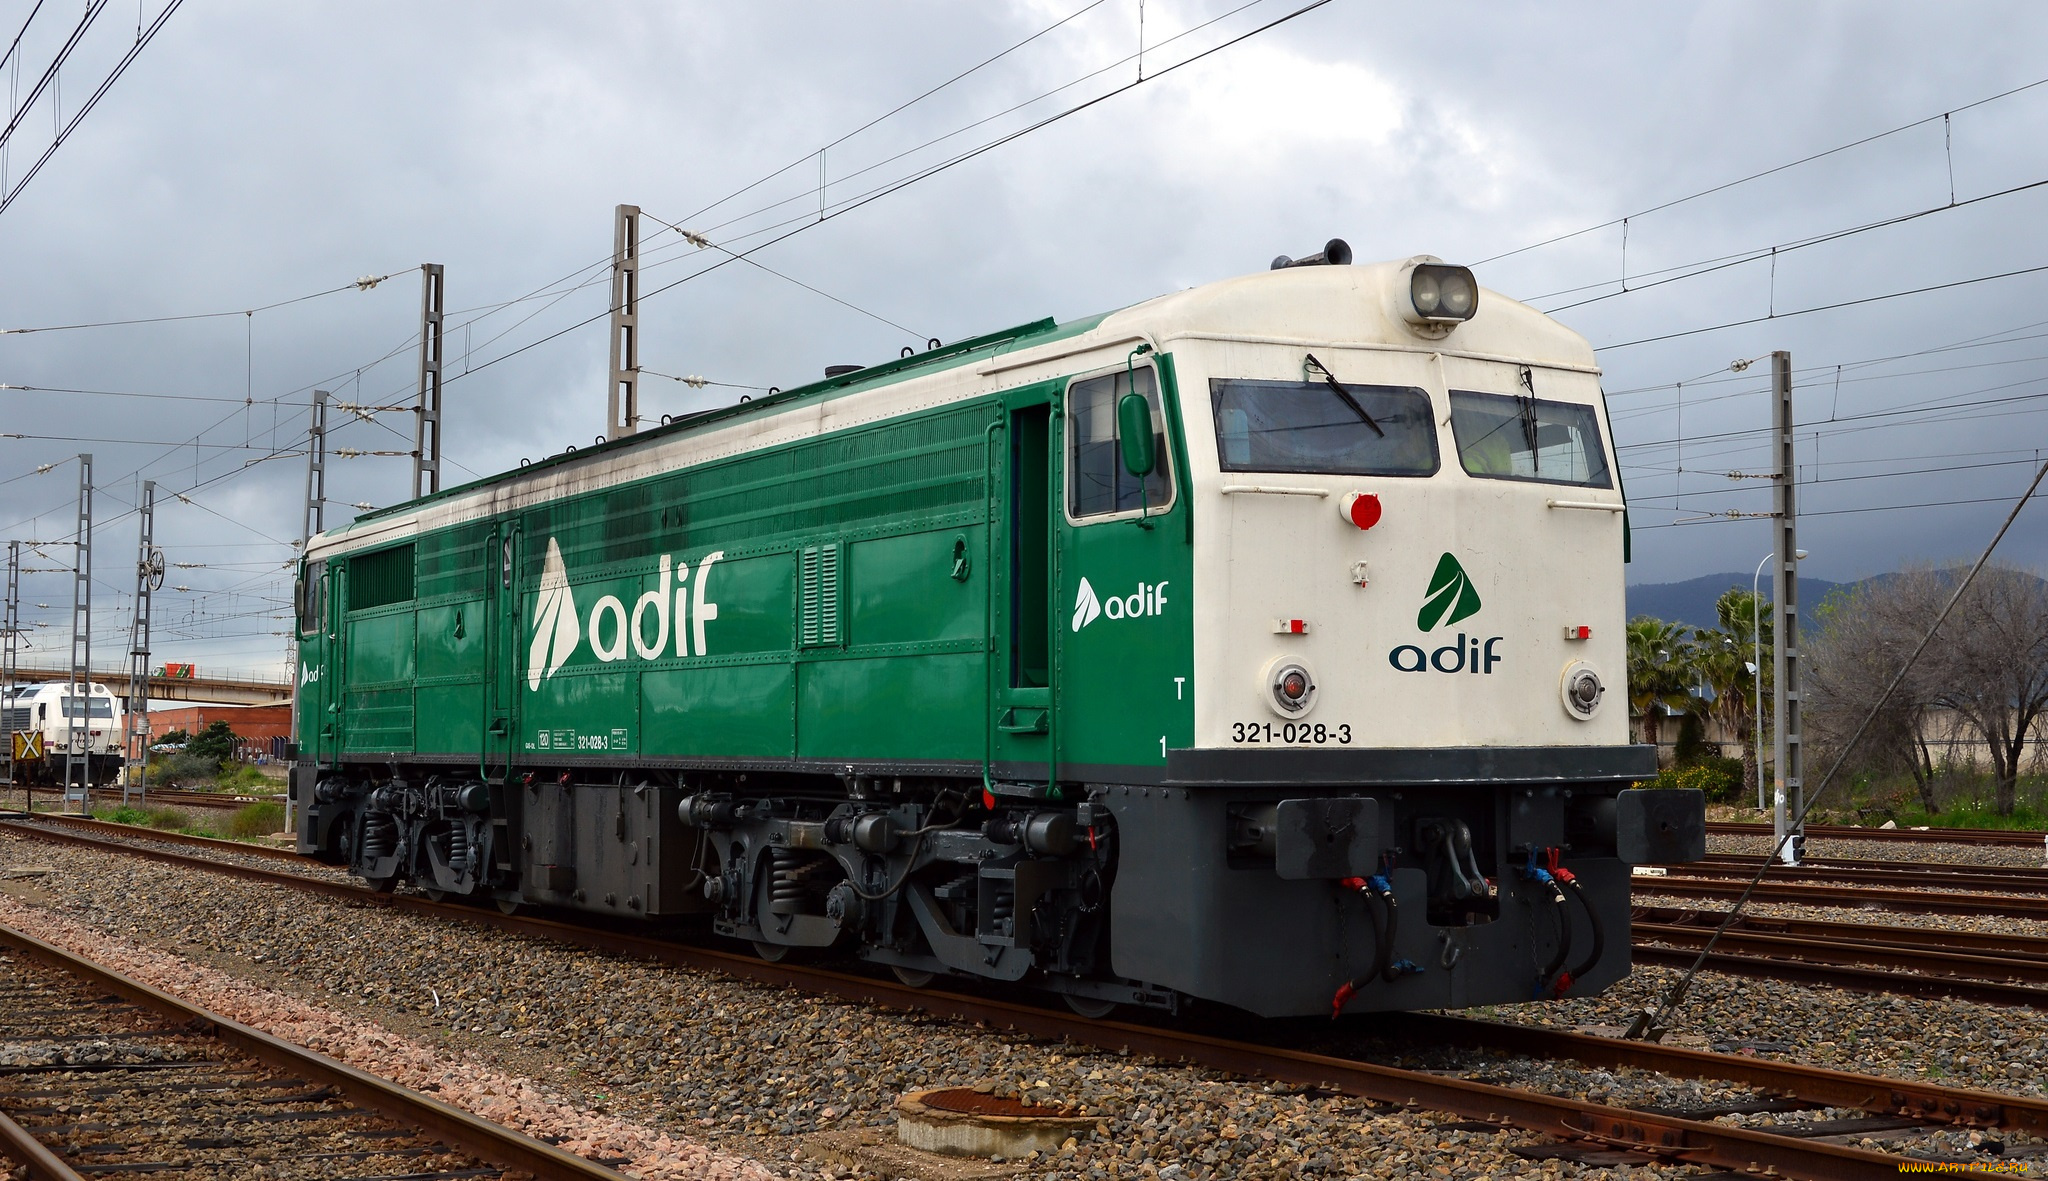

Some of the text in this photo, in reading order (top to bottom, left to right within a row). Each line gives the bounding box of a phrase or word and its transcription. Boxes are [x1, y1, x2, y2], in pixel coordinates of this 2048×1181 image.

[589, 551, 724, 662] adif
[1105, 581, 1169, 619] adif
[1389, 633, 1504, 674] adif
[309, 664, 324, 682] adf
[1174, 677, 1185, 700] T
[577, 735, 608, 750] 321-028-3
[1232, 722, 1352, 744] 321-028-3
[1159, 735, 1166, 758] 1
